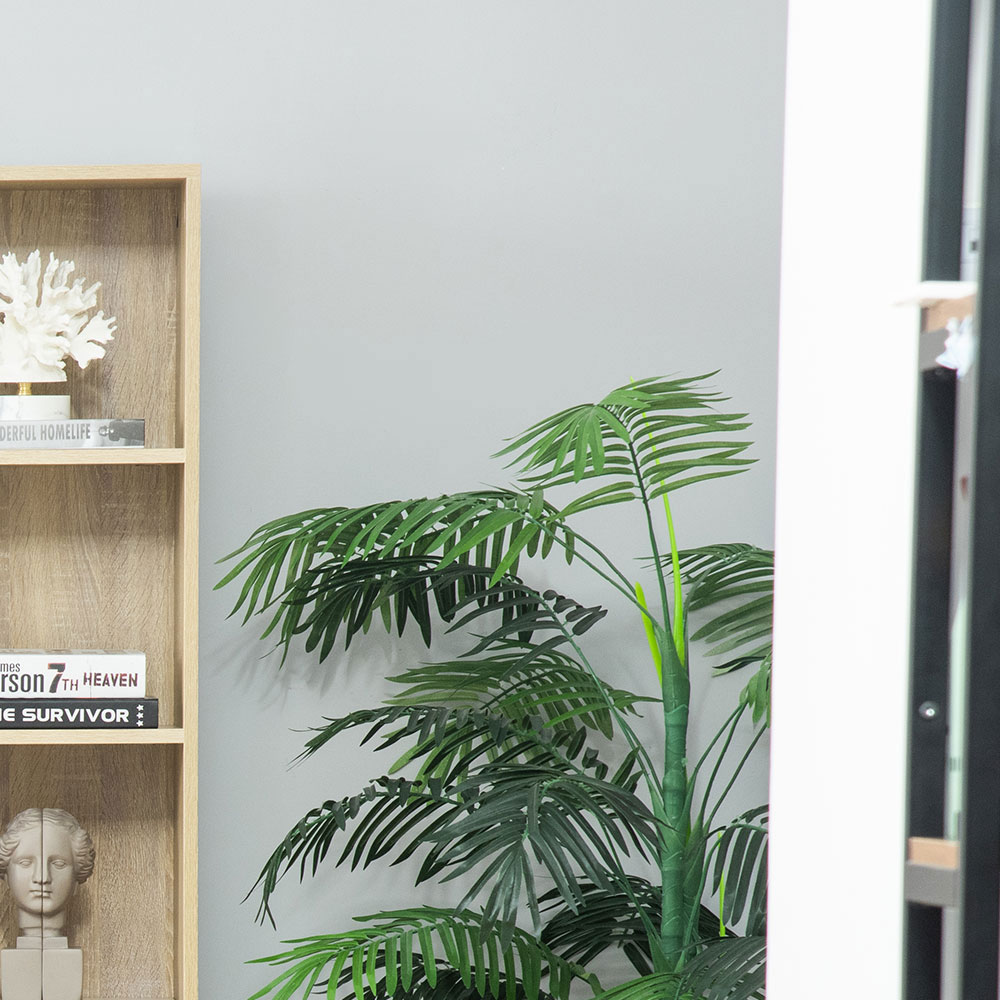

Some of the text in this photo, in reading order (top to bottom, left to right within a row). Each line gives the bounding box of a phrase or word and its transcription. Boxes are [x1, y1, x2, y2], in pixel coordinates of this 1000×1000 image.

[40, 423, 91, 440] HOMELIFE
[83, 672, 138, 687] HEAVEN
[22, 708, 129, 723] SURVIVOR
